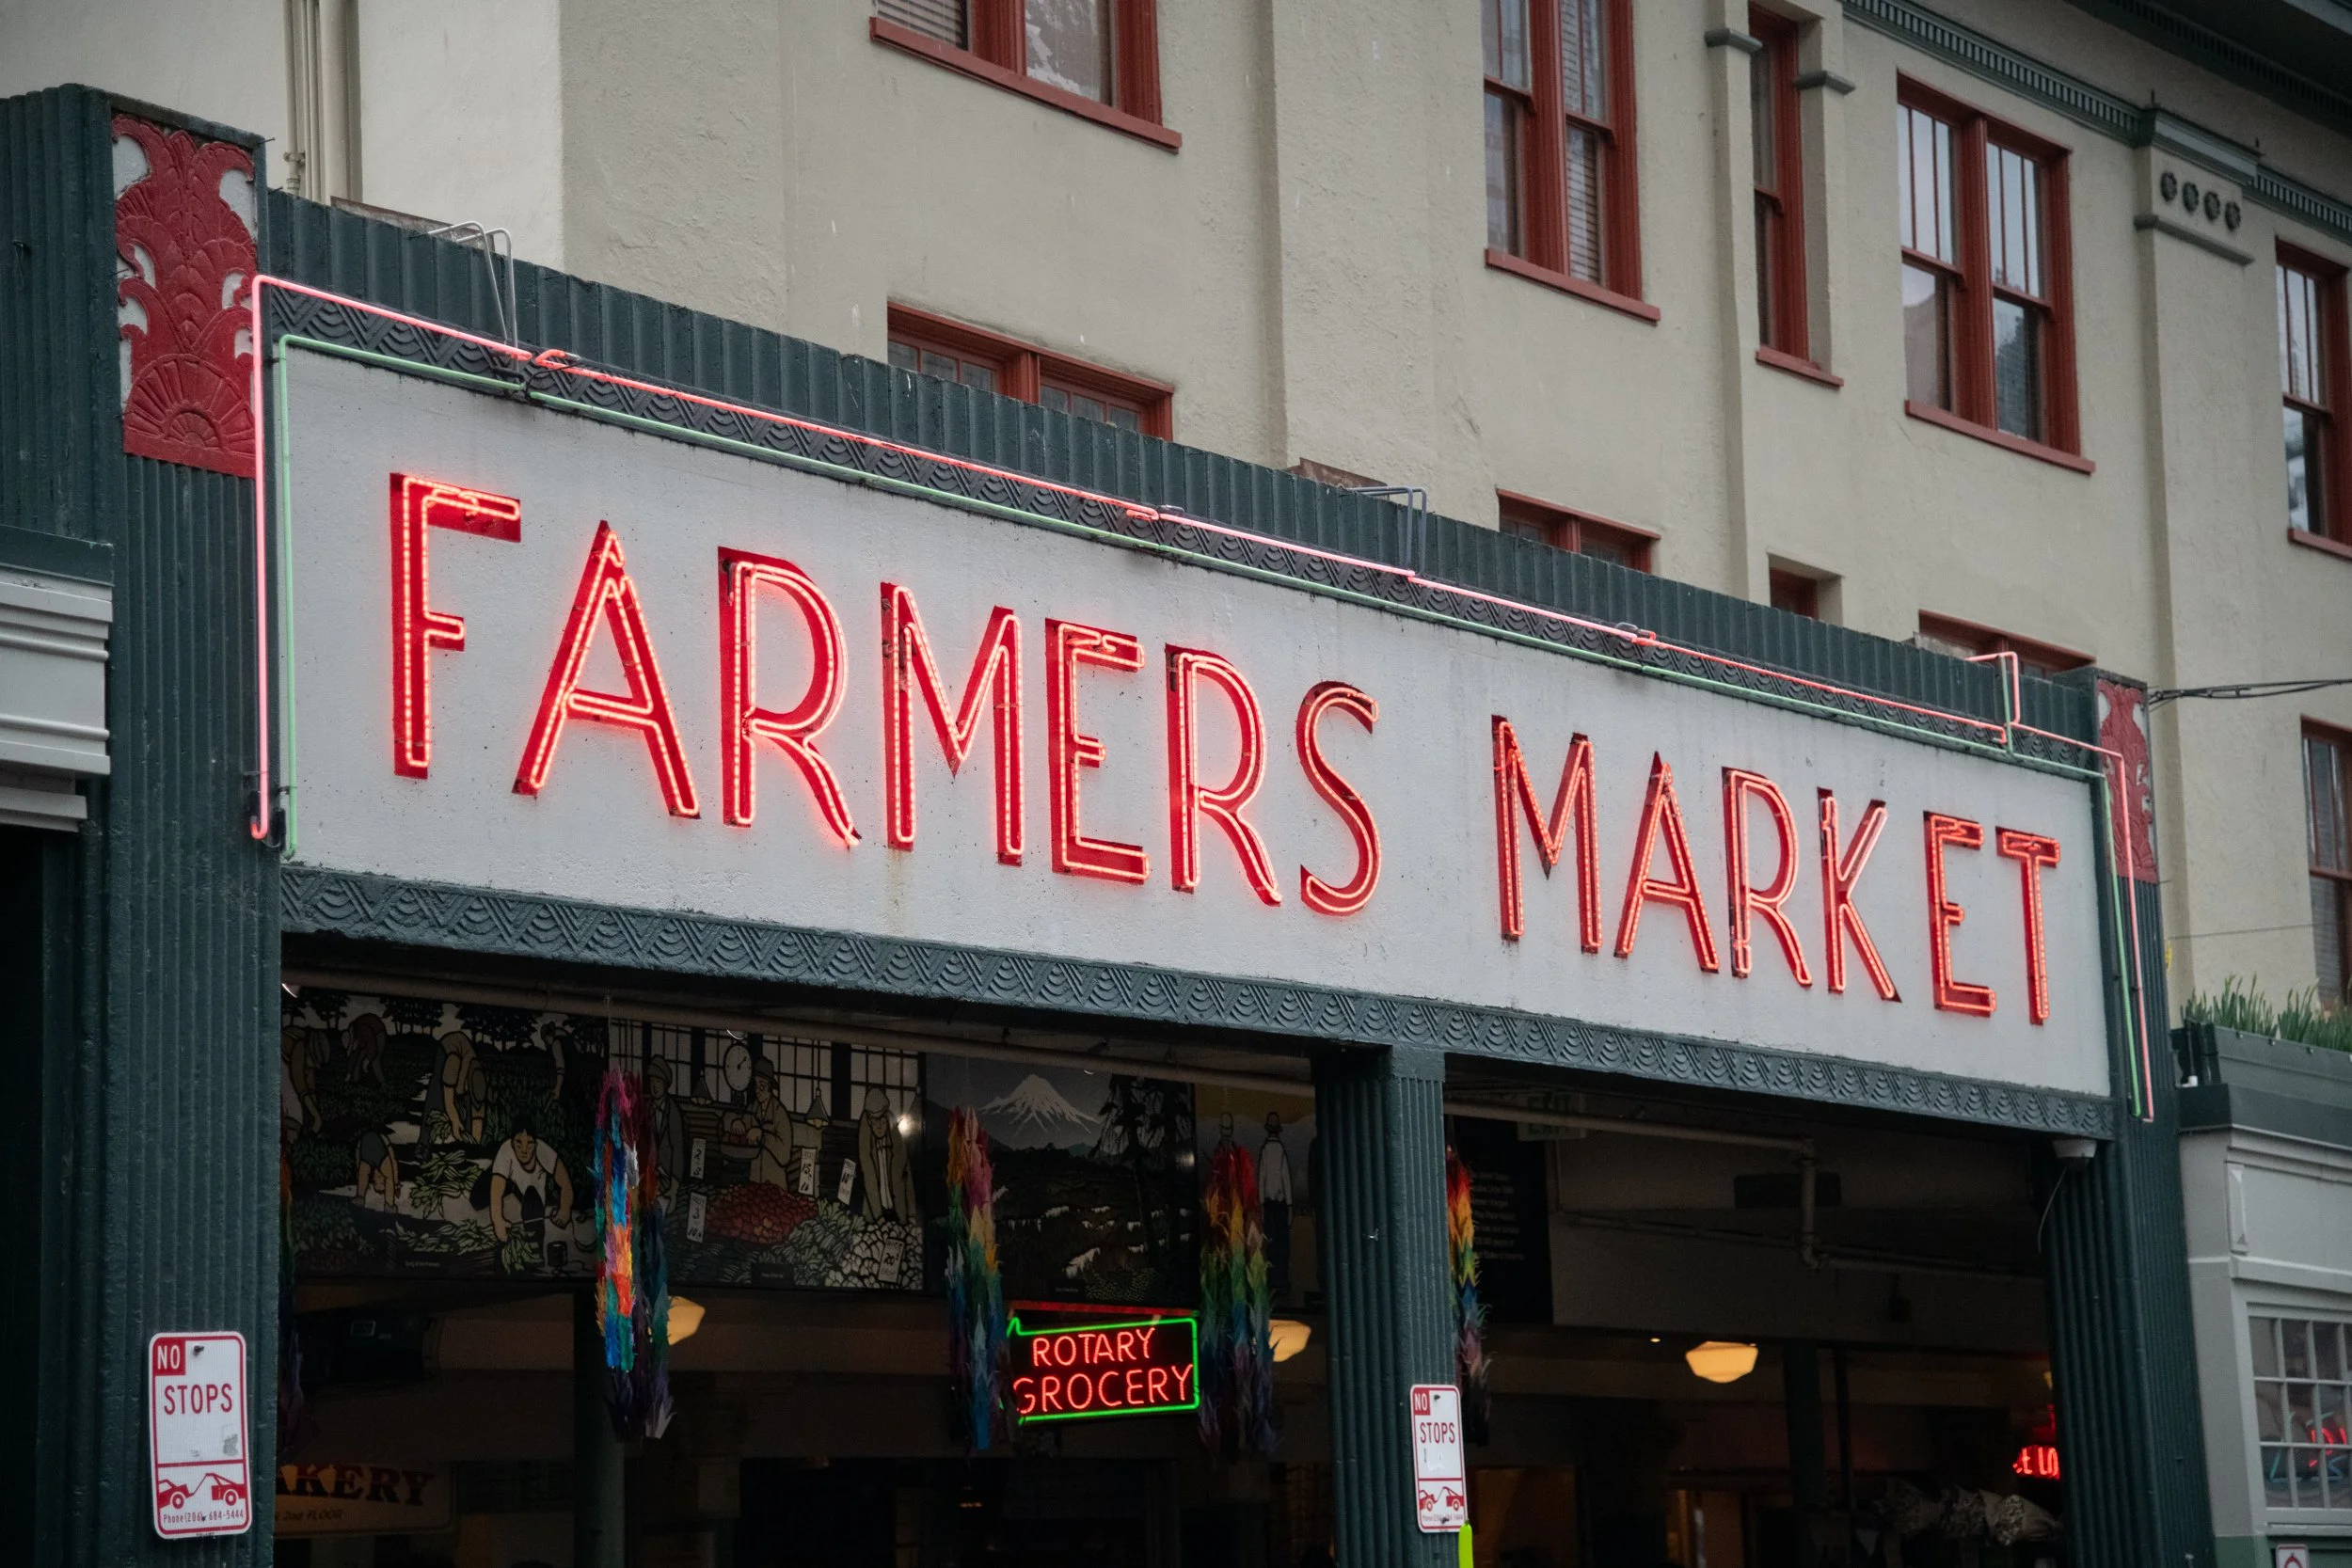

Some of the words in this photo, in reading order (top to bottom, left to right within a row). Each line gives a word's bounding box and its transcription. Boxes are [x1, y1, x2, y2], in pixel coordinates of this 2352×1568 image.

[389, 472, 1382, 916] FARMERS
[1491, 714, 2061, 1026] MARKET
[157, 1344, 181, 1370] NO
[1032, 1327, 1155, 1366] ROTARY
[164, 1383, 232, 1416] STOPS
[1012, 1364, 1194, 1414] GROCERY
[1414, 1393, 1428, 1411] NO
[1420, 1421, 1455, 1444] STOPS
